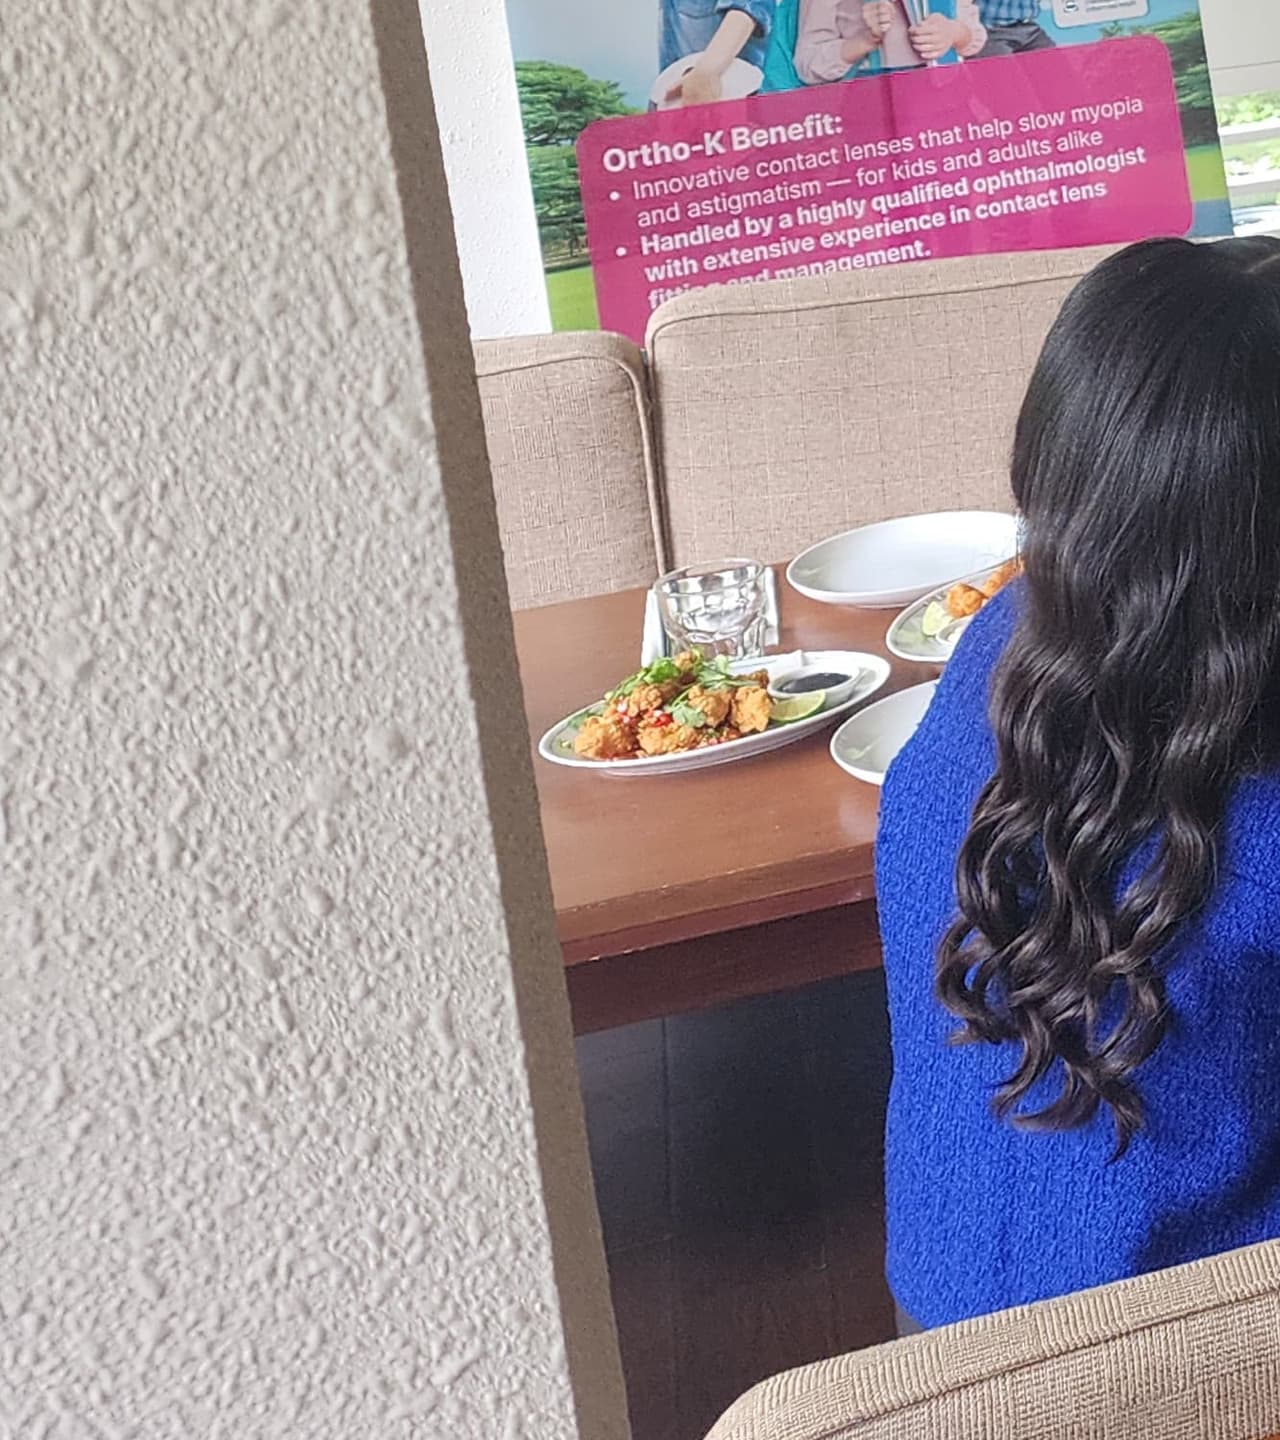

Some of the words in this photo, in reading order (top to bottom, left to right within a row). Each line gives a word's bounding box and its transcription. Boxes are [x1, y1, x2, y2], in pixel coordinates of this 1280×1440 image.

[603, 130, 726, 172] Ortho-K
[731, 114, 842, 151] Benefit:
[634, 164, 749, 199] Innovative
[756, 148, 839, 178] contact
[845, 135, 913, 162] lenses
[919, 127, 962, 149] that
[968, 118, 1013, 141] help
[1019, 110, 1065, 132] slow
[1071, 95, 1143, 123] myopia
[637, 203, 680, 227] and
[687, 180, 821, 217] astigmatism
[856, 167, 885, 187] for
[892, 158, 937, 180] kids
[944, 149, 982, 171] and
[988, 137, 1051, 163] adults
[1056, 130, 1103, 152] alike
[640, 219, 739, 255] Handled
[745, 215, 773, 241] by
[779, 214, 792, 229] a
[798, 195, 866, 225] highly
[872, 178, 968, 213] qualified
[973, 147, 1146, 195] ophthalmologist
[645, 258, 698, 281] with
[703, 235, 814, 270] extensive
[821, 211, 945, 252] experience
[950, 206, 969, 224] in
[976, 190, 1057, 219] contact
[1062, 181, 1107, 203] lens
[774, 239, 931, 280] management.
